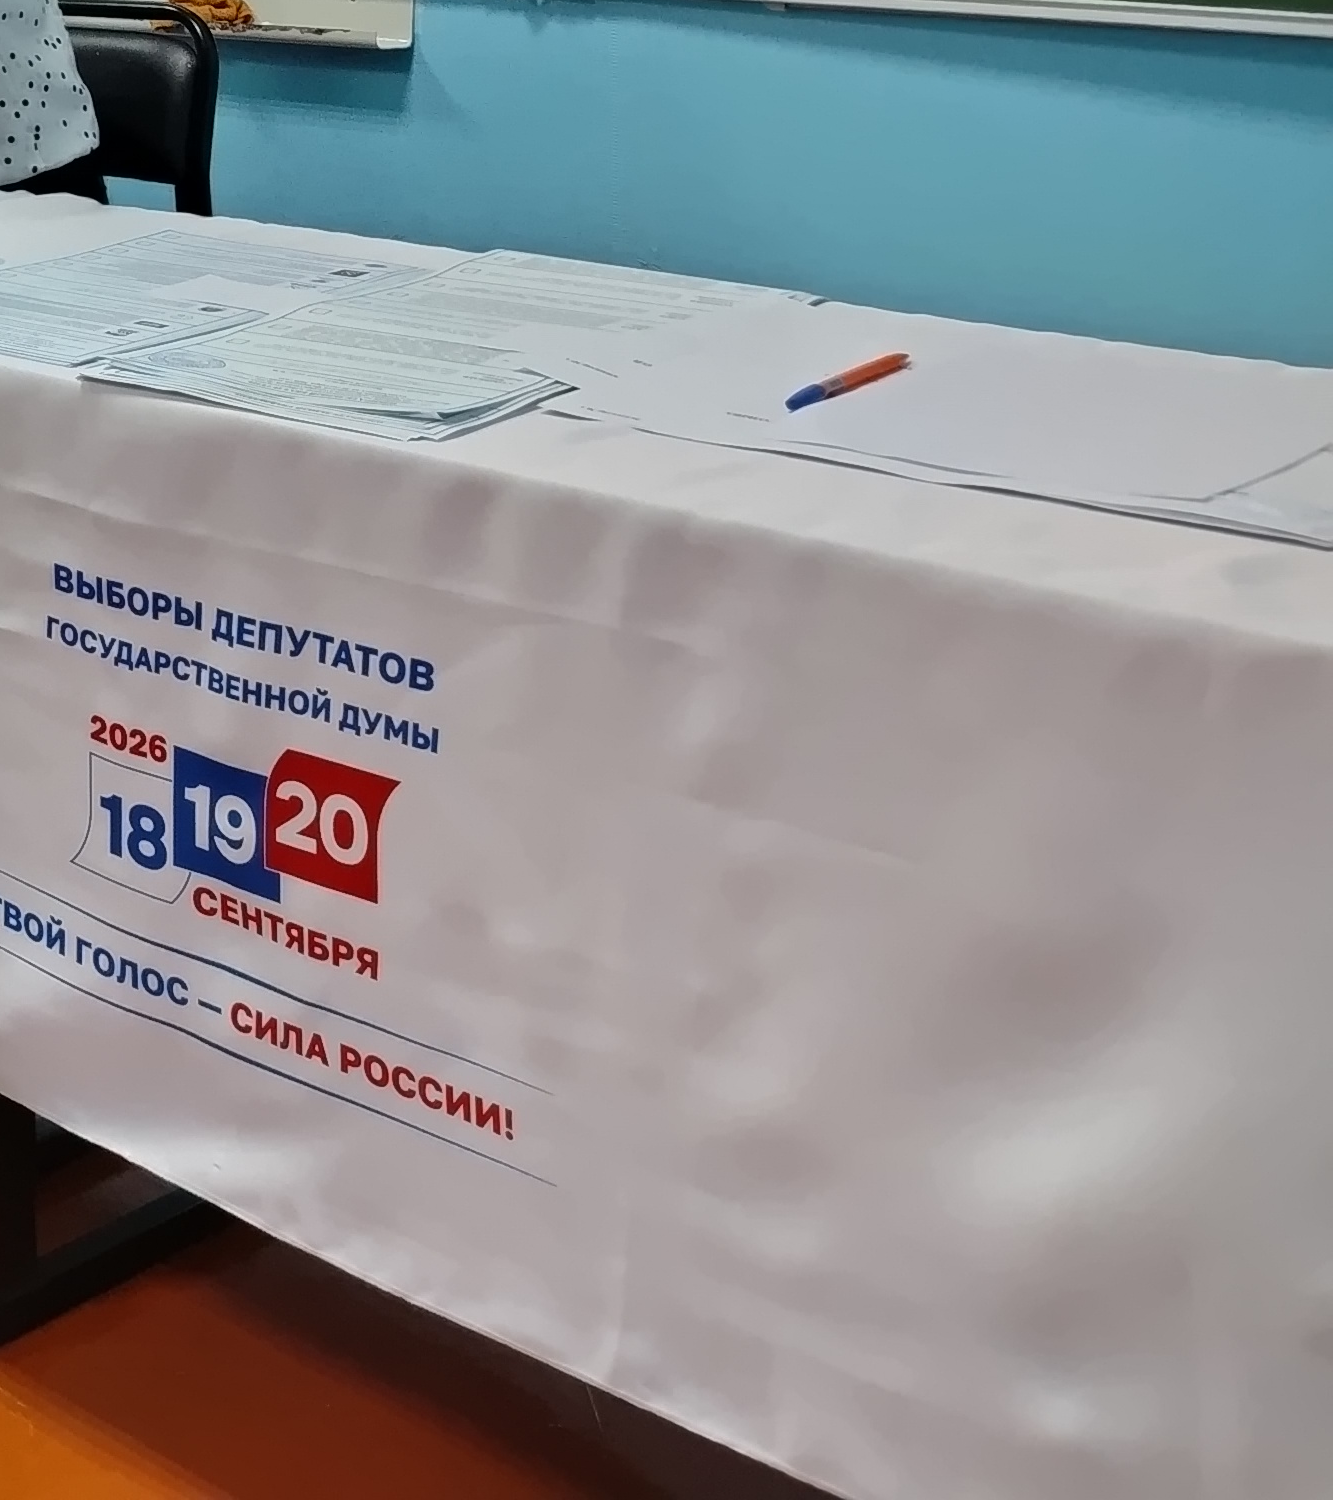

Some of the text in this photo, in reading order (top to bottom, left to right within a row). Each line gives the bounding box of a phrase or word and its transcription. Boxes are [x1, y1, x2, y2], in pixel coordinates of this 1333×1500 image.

[52, 562, 435, 693] ВЫБОРЫ ДЕПУТАТОВ
[46, 615, 440, 754] ГОСУДАРСТВЕННОЙ ДУМЫ
[89, 714, 168, 763] 2026
[100, 779, 370, 871] 18 19 20
[192, 885, 379, 981] СЕНТЯБРЯ
[76, 938, 190, 1006] ГОЛОС
[230, 1001, 329, 1066] СИЛА
[340, 1042, 515, 1141] РОССИИ!
